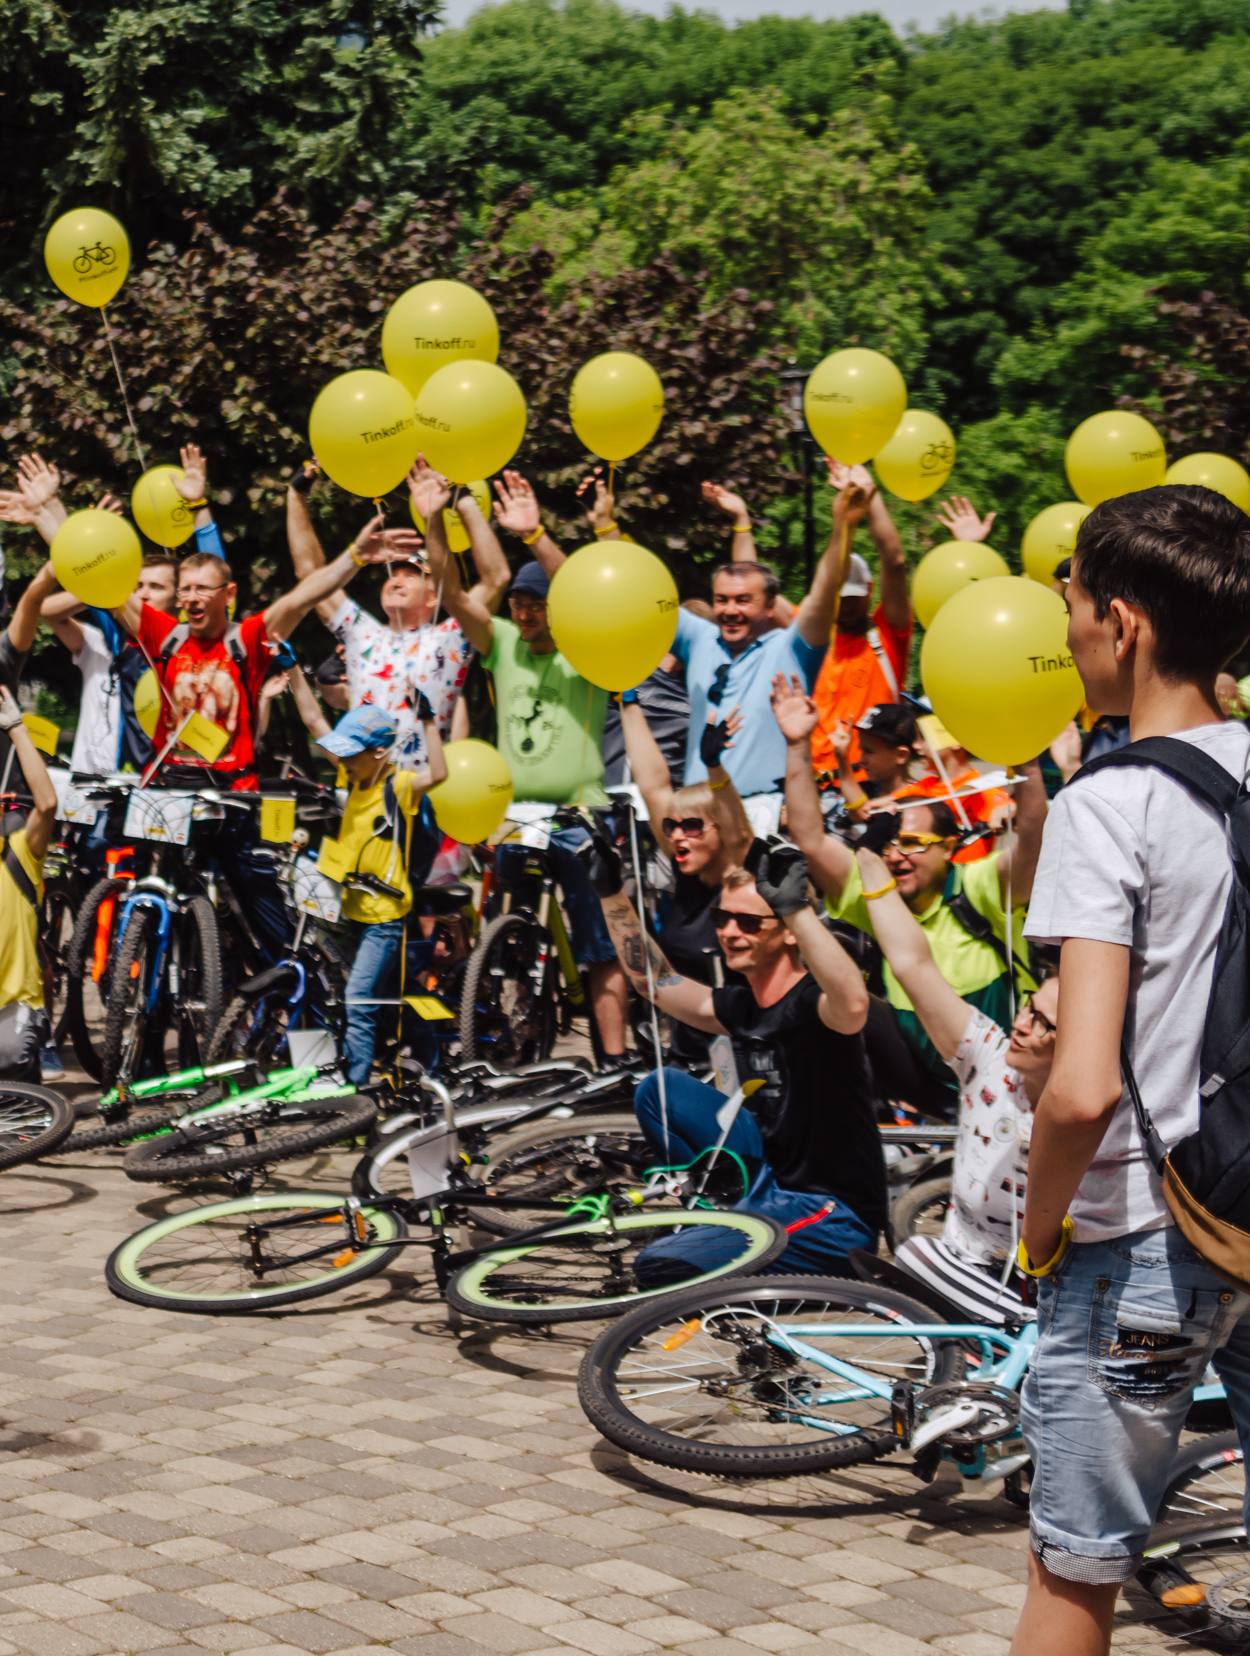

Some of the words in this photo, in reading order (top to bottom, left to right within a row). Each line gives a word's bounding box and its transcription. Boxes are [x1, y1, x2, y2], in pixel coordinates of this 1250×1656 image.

[413, 337, 475, 350] Tinkoff.ru
[71, 549, 117, 577] Tinkoff.ru
[1027, 654, 1075, 673] Tinko
[1126, 1334, 1170, 1347] JEANS
